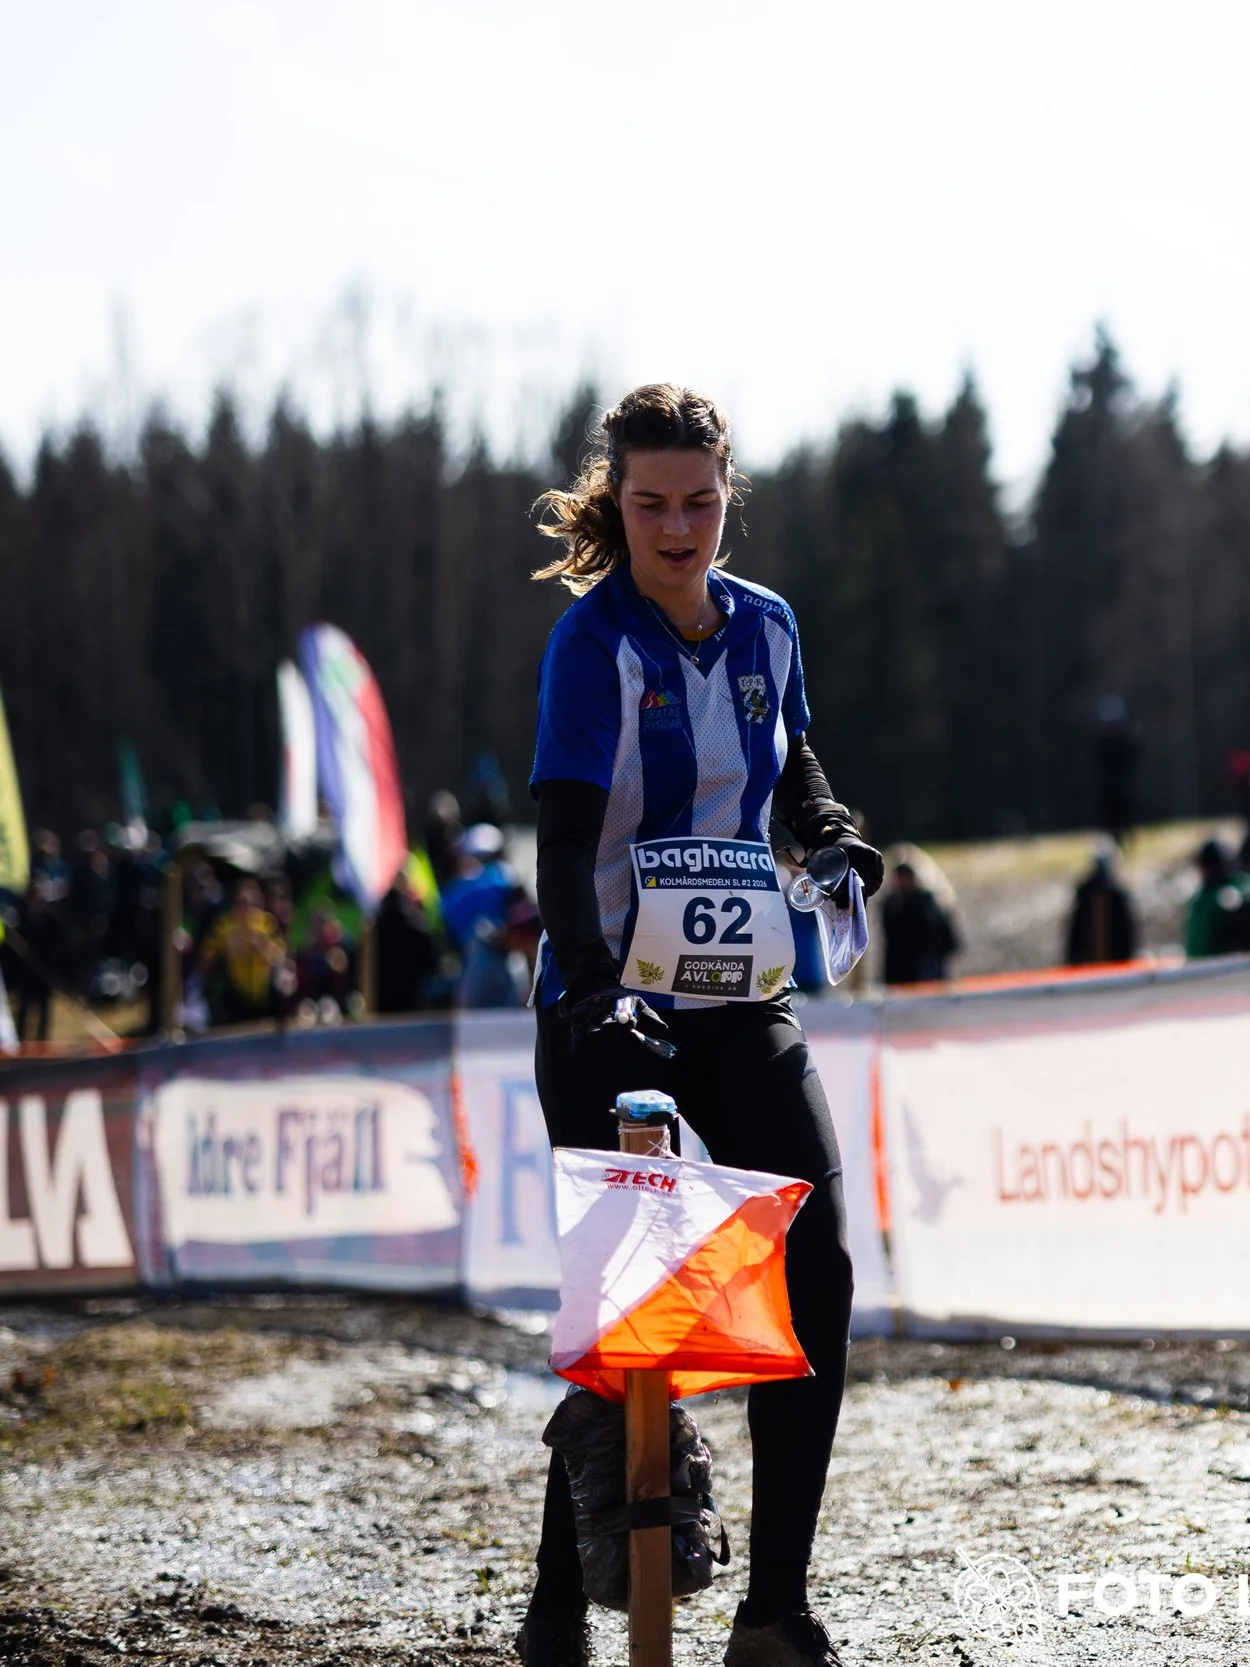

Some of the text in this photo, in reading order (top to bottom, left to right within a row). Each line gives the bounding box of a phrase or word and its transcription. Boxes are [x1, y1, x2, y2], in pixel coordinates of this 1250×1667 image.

[637, 843, 774, 872] bagheera
[659, 875, 768, 888] KOLMÅRDSMEDELN SL #2 2026
[682, 896, 753, 945] 62
[684, 960, 745, 971] GODKÄNDA
[275, 1103, 386, 1217] Fjäll
